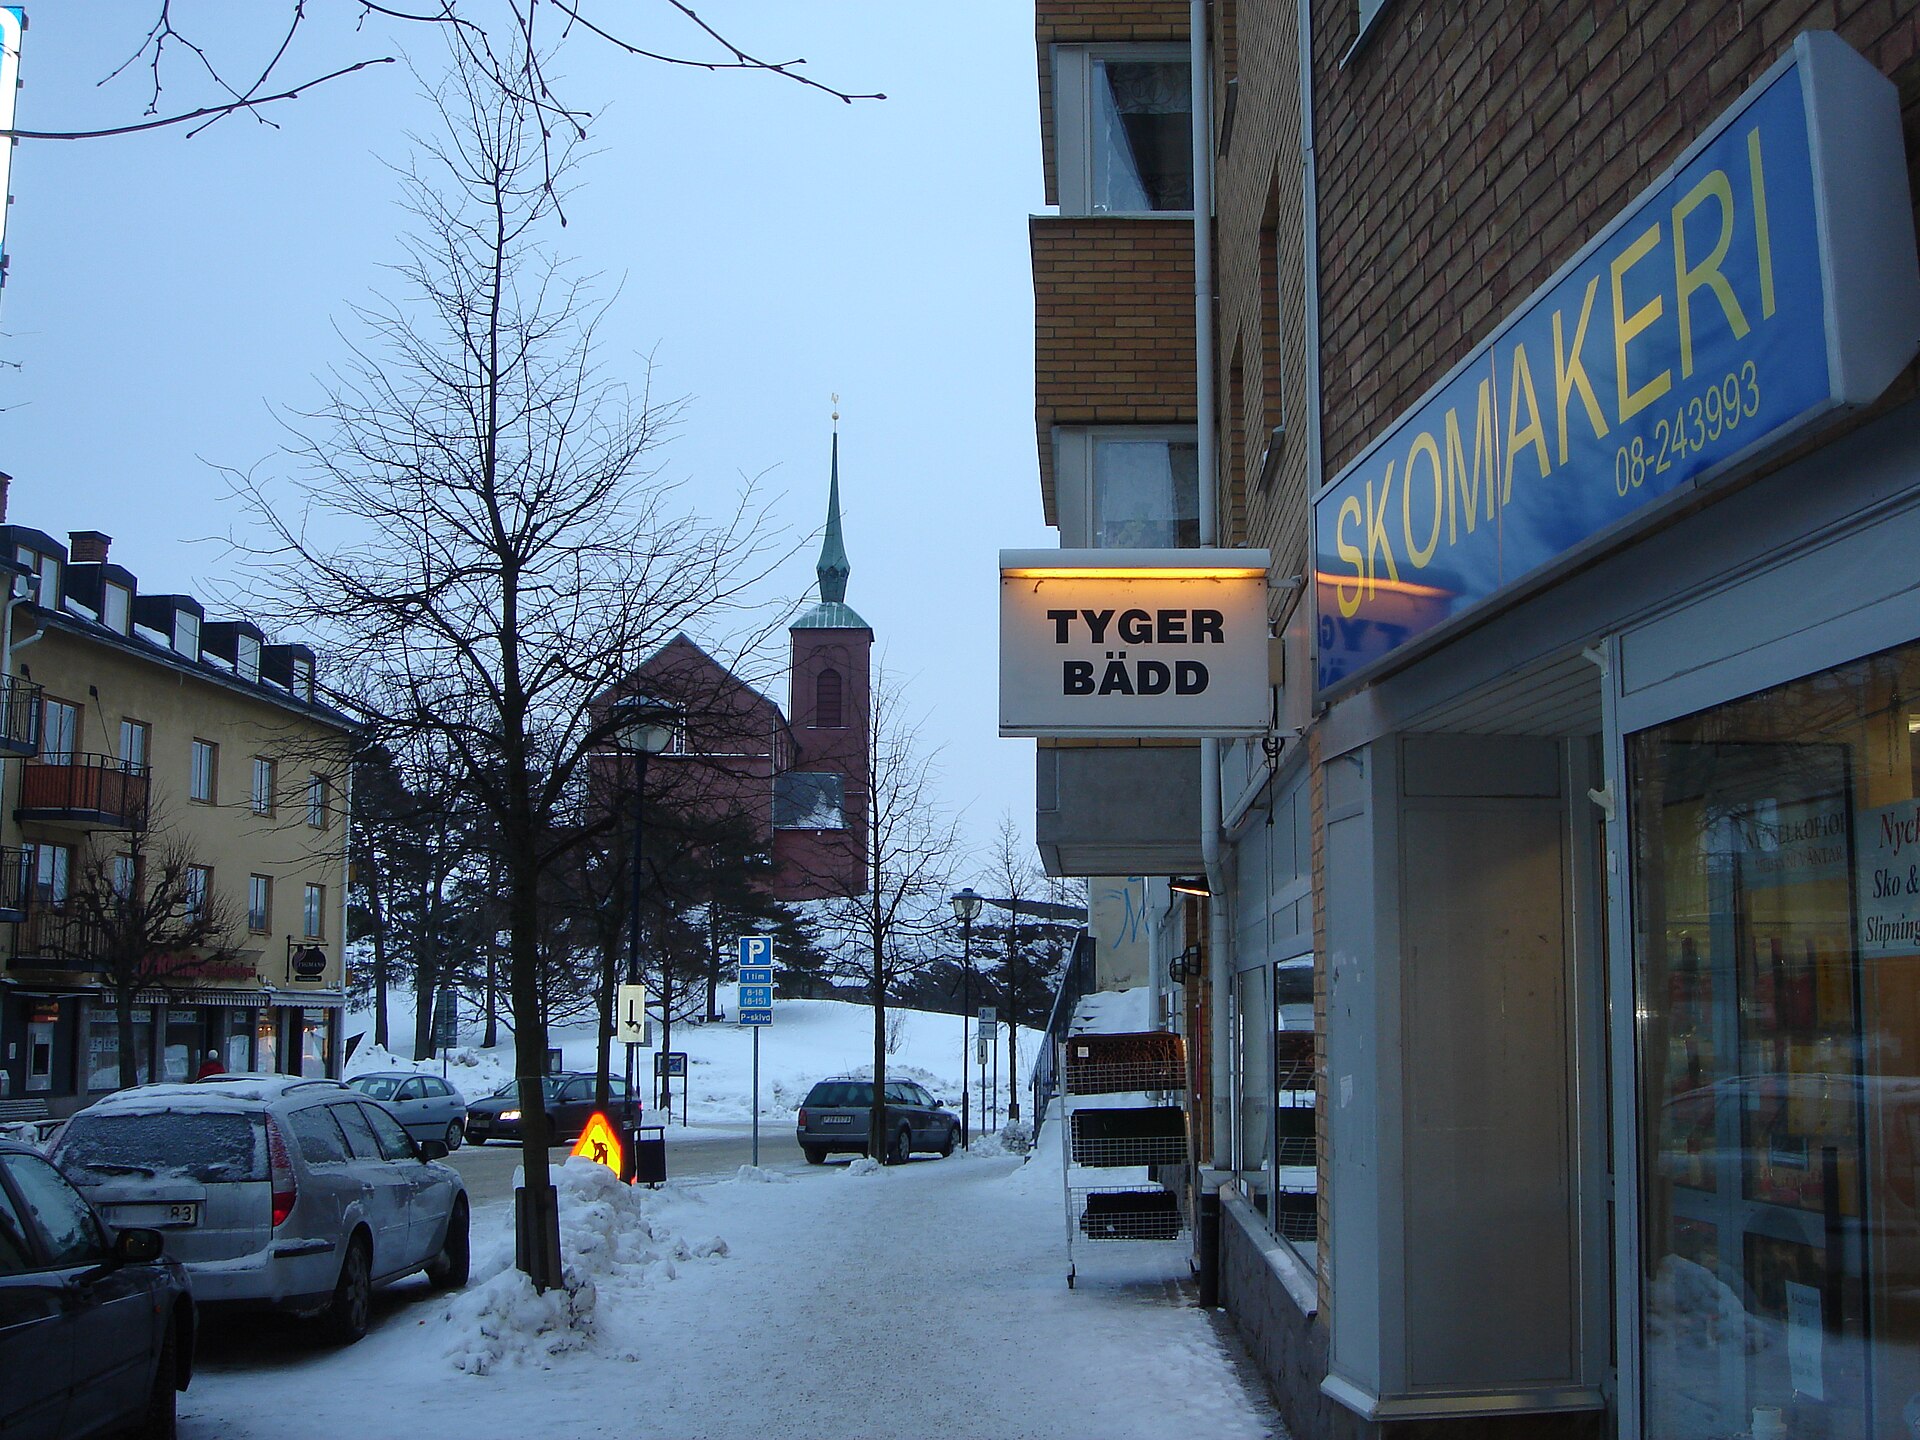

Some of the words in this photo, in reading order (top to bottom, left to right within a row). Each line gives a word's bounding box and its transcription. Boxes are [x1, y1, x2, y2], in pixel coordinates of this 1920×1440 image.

[1336, 126, 1776, 618] SKOMAKERI
[1614, 360, 1760, 497] 08-243993
[1047, 608, 1225, 644] TYGER
[1063, 651, 1209, 695] BÄDD
[1873, 868, 1900, 899] Sko
[1906, 864, 1919, 895] &
[749, 939, 765, 964] P
[746, 989, 764, 997] 8-18
[740, 1013, 771, 1021] P-skiva
